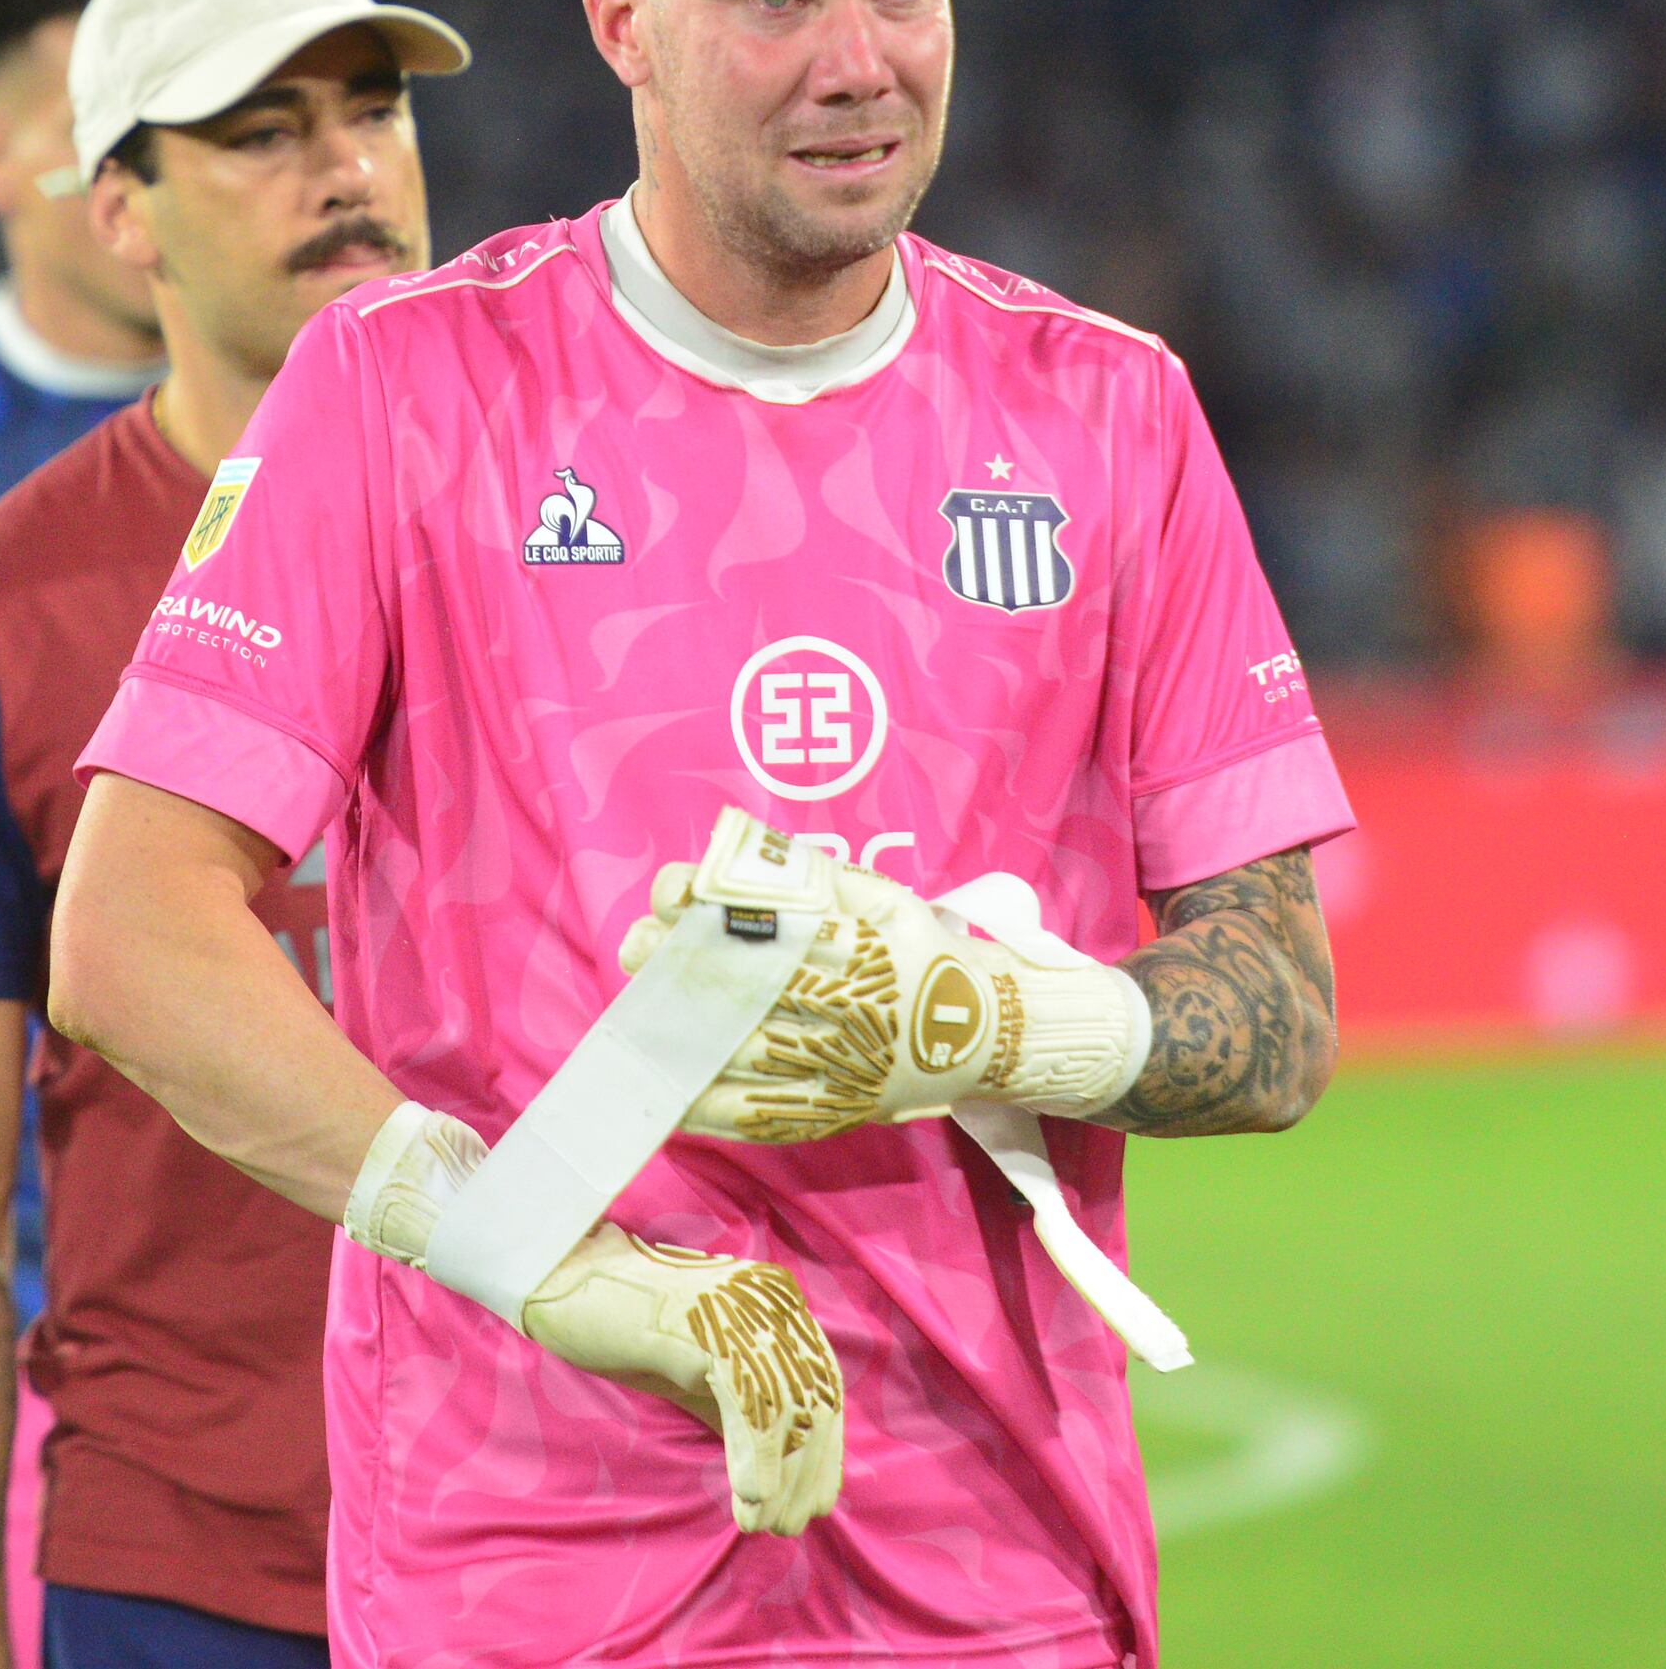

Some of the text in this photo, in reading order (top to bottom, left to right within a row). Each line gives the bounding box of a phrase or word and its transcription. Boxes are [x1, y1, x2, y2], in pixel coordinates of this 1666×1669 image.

[525, 546, 622, 562] LE COQ SPORTIF
